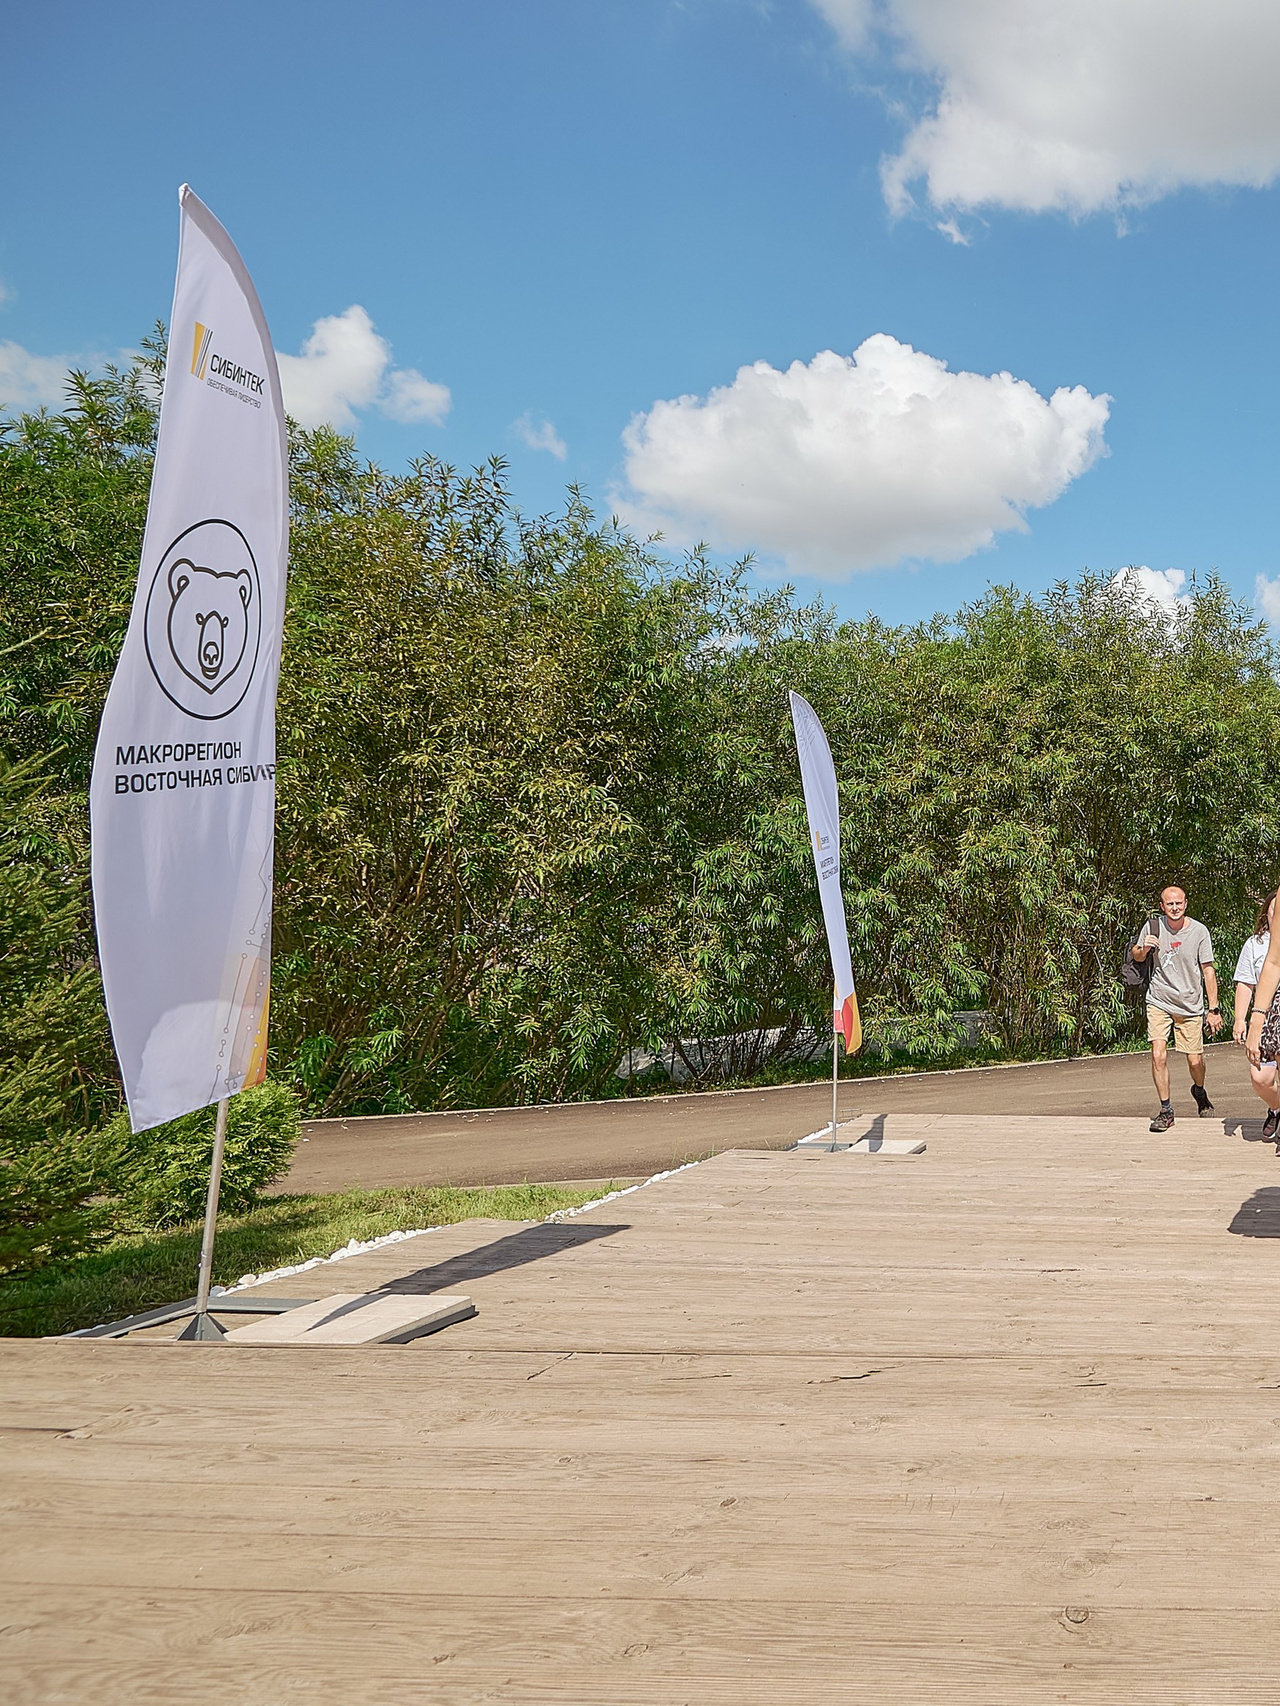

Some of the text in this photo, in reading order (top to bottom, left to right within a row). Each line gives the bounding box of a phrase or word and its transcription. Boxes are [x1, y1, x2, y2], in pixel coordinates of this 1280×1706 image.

[210, 354, 265, 395] СИБИНТЕК
[115, 741, 242, 765] МАКРОРЕГИОН
[115, 764, 276, 794] ВОСТОЧНАЯ СИБИР
